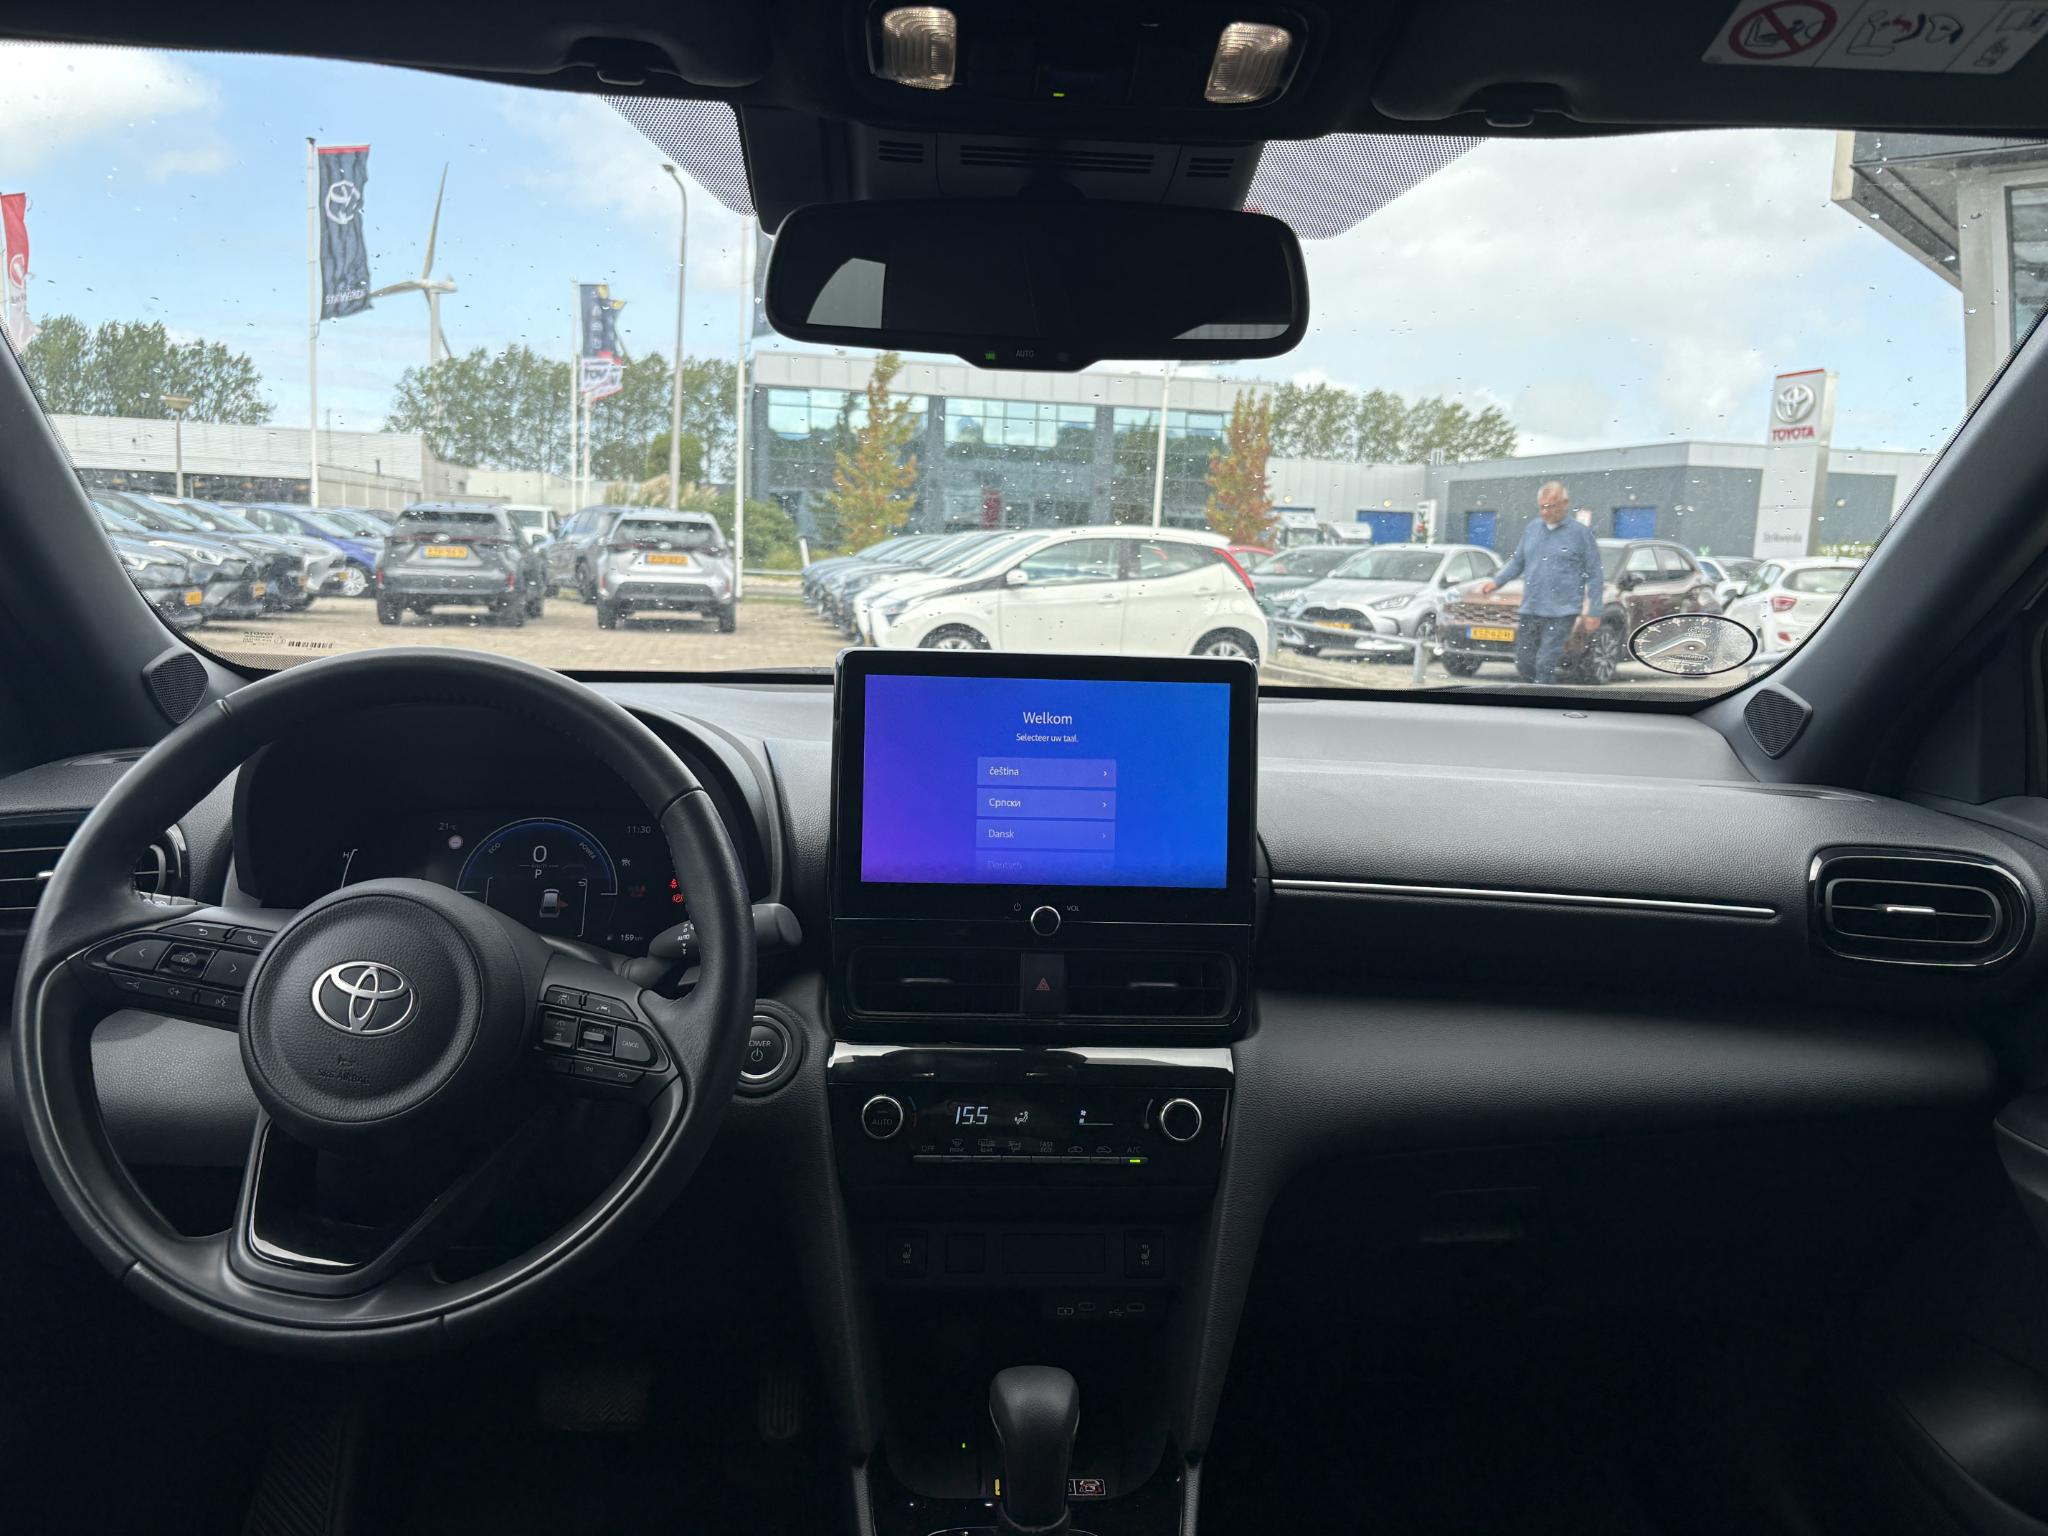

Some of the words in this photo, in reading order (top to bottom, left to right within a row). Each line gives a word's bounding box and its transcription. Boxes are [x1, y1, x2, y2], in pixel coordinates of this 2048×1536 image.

[1015, 349, 1035, 358] AUTO
[1771, 426, 1815, 441] TOYOTA
[1022, 711, 1073, 725] Welkom
[1016, 733, 1049, 742] Selecteer
[1050, 735, 1062, 743] uw
[1063, 734, 1079, 743] taal.
[989, 766, 1019, 776] čeština
[988, 797, 1021, 808] Српски
[627, 825, 652, 834] 11:30
[988, 828, 1015, 839] Dansk
[488, 842, 501, 854] ECO
[578, 841, 597, 860] POWER
[532, 845, 548, 863] 0
[534, 868, 543, 880] P
[1066, 904, 1081, 912] VOL
[676, 934, 691, 942] AUTO
[621, 1041, 640, 1049] CANCEL
[748, 1040, 772, 1048] OWER
[871, 1117, 893, 1126] AUTO
[920, 1144, 937, 1153] OFF
[1126, 1145, 1141, 1153] A/C
